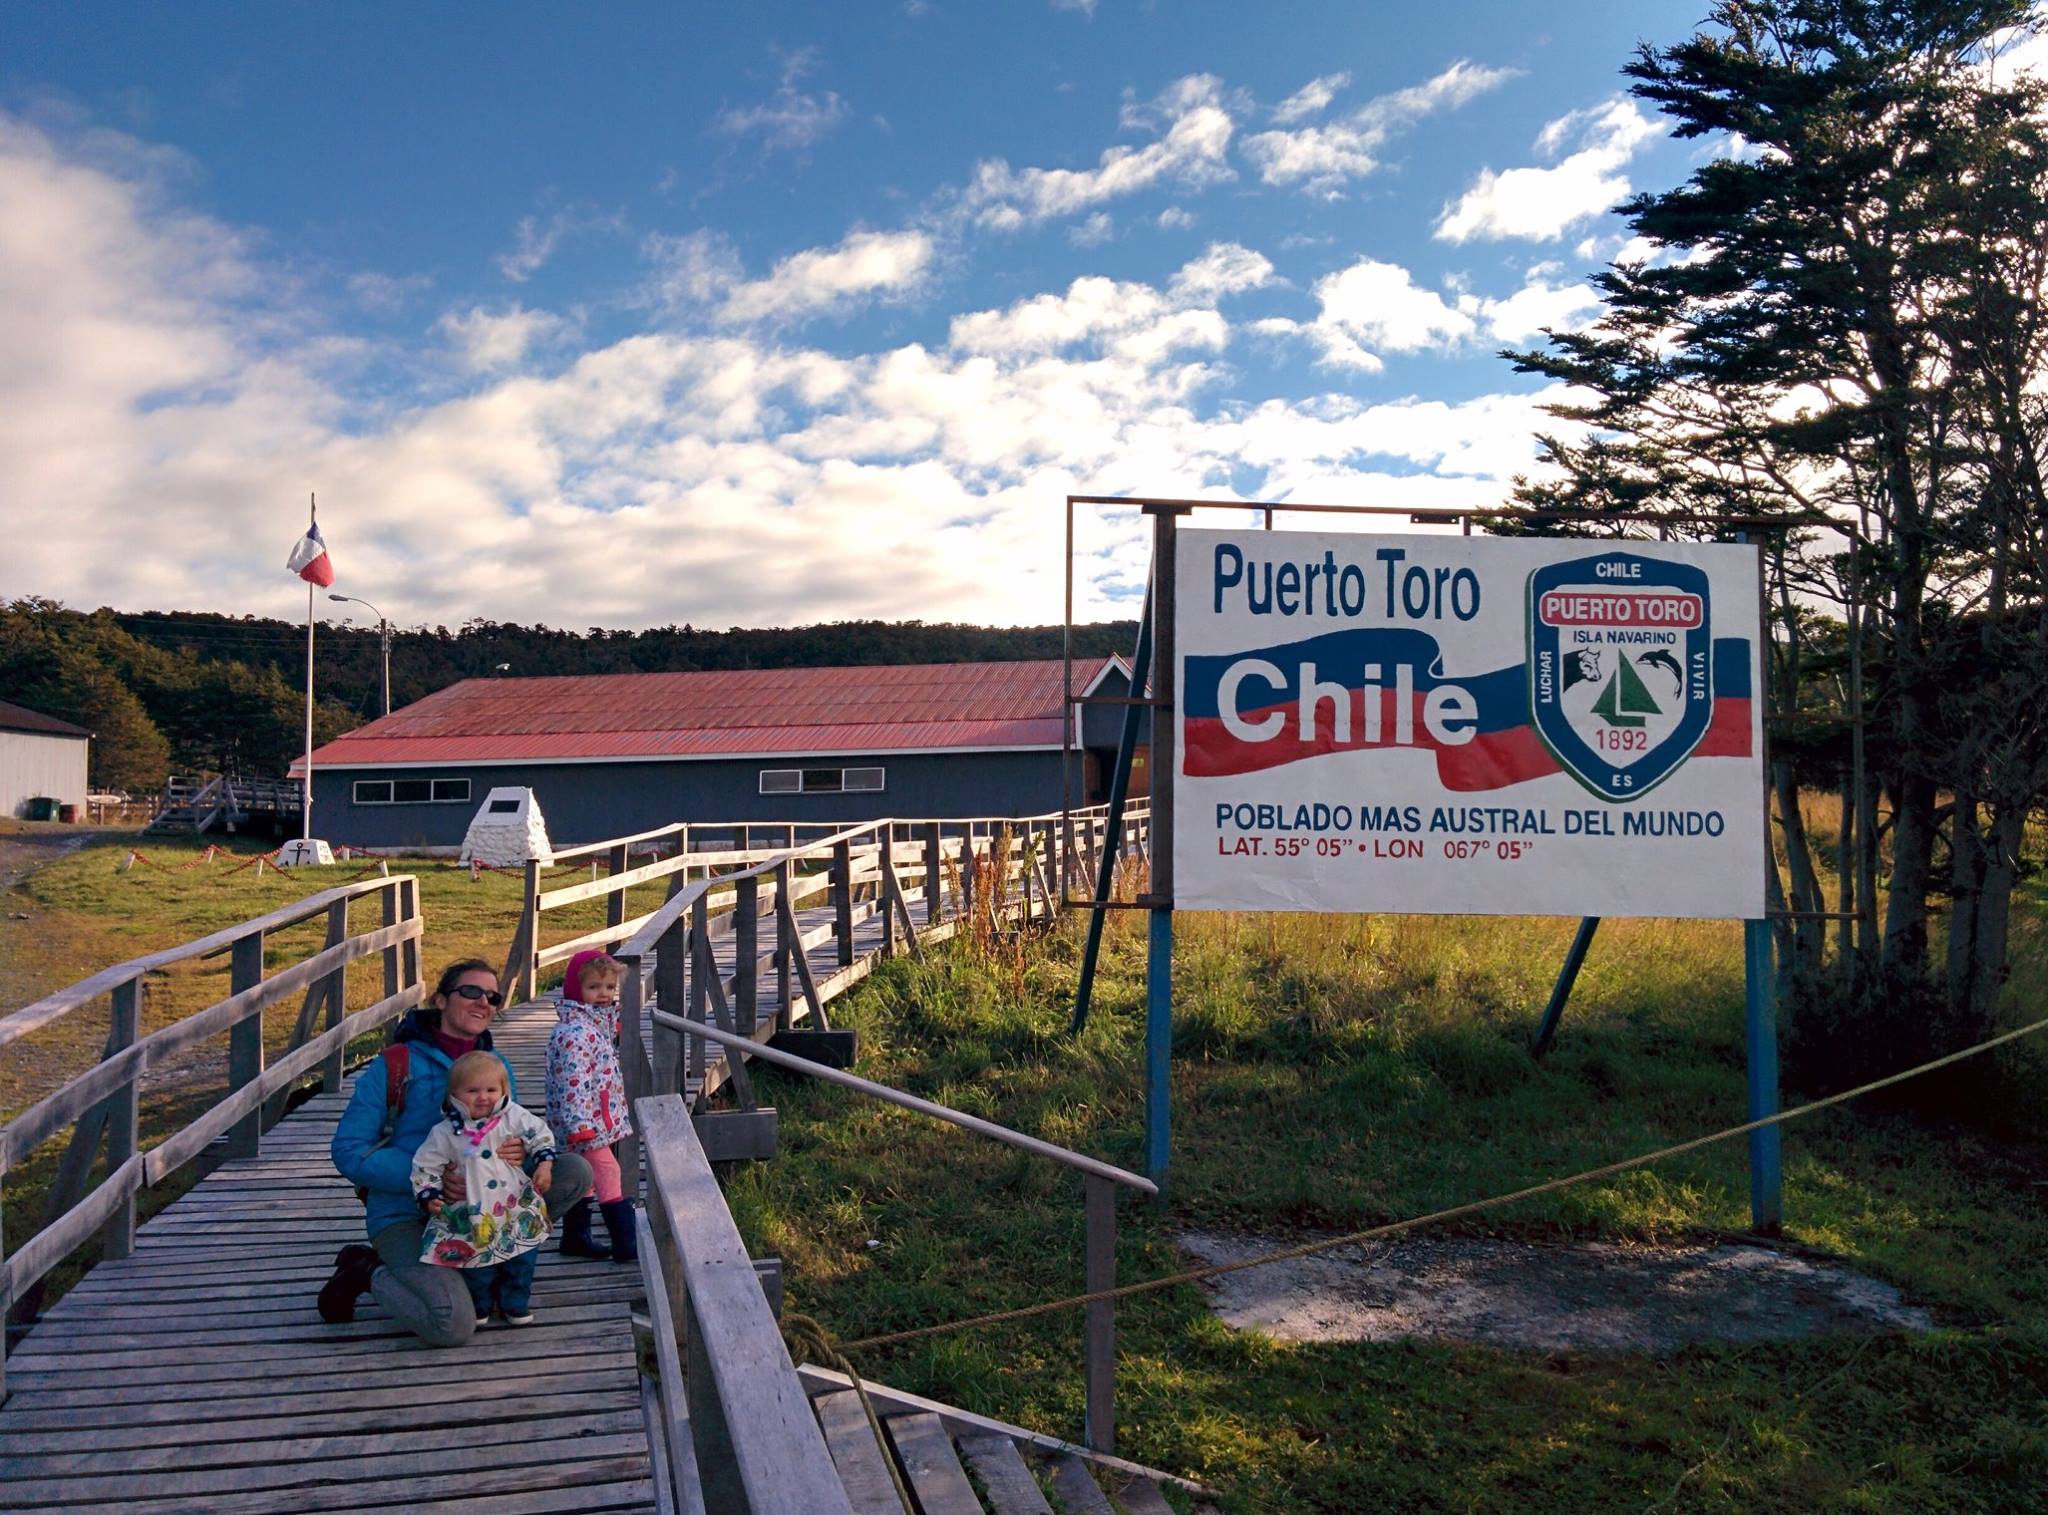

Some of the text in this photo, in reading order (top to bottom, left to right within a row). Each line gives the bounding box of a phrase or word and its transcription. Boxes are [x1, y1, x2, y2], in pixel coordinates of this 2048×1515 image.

[1213, 543, 1481, 621] Puerto Toro
[1595, 562, 1642, 578] CHILE
[1546, 597, 1696, 622] PUERTO TORO
[1573, 630, 1676, 645] ISLA NAVARINO
[1540, 651, 1553, 704] LUCHAR
[1692, 652, 1705, 701] VIVIR
[1217, 658, 1479, 745] Chile
[1595, 729, 1647, 751] 1892
[1216, 803, 1725, 837] POBLADO MAS AUSTRAL DEL MUNDO
[1218, 836, 1268, 857] LAT.
[1374, 839, 1424, 858] LON
